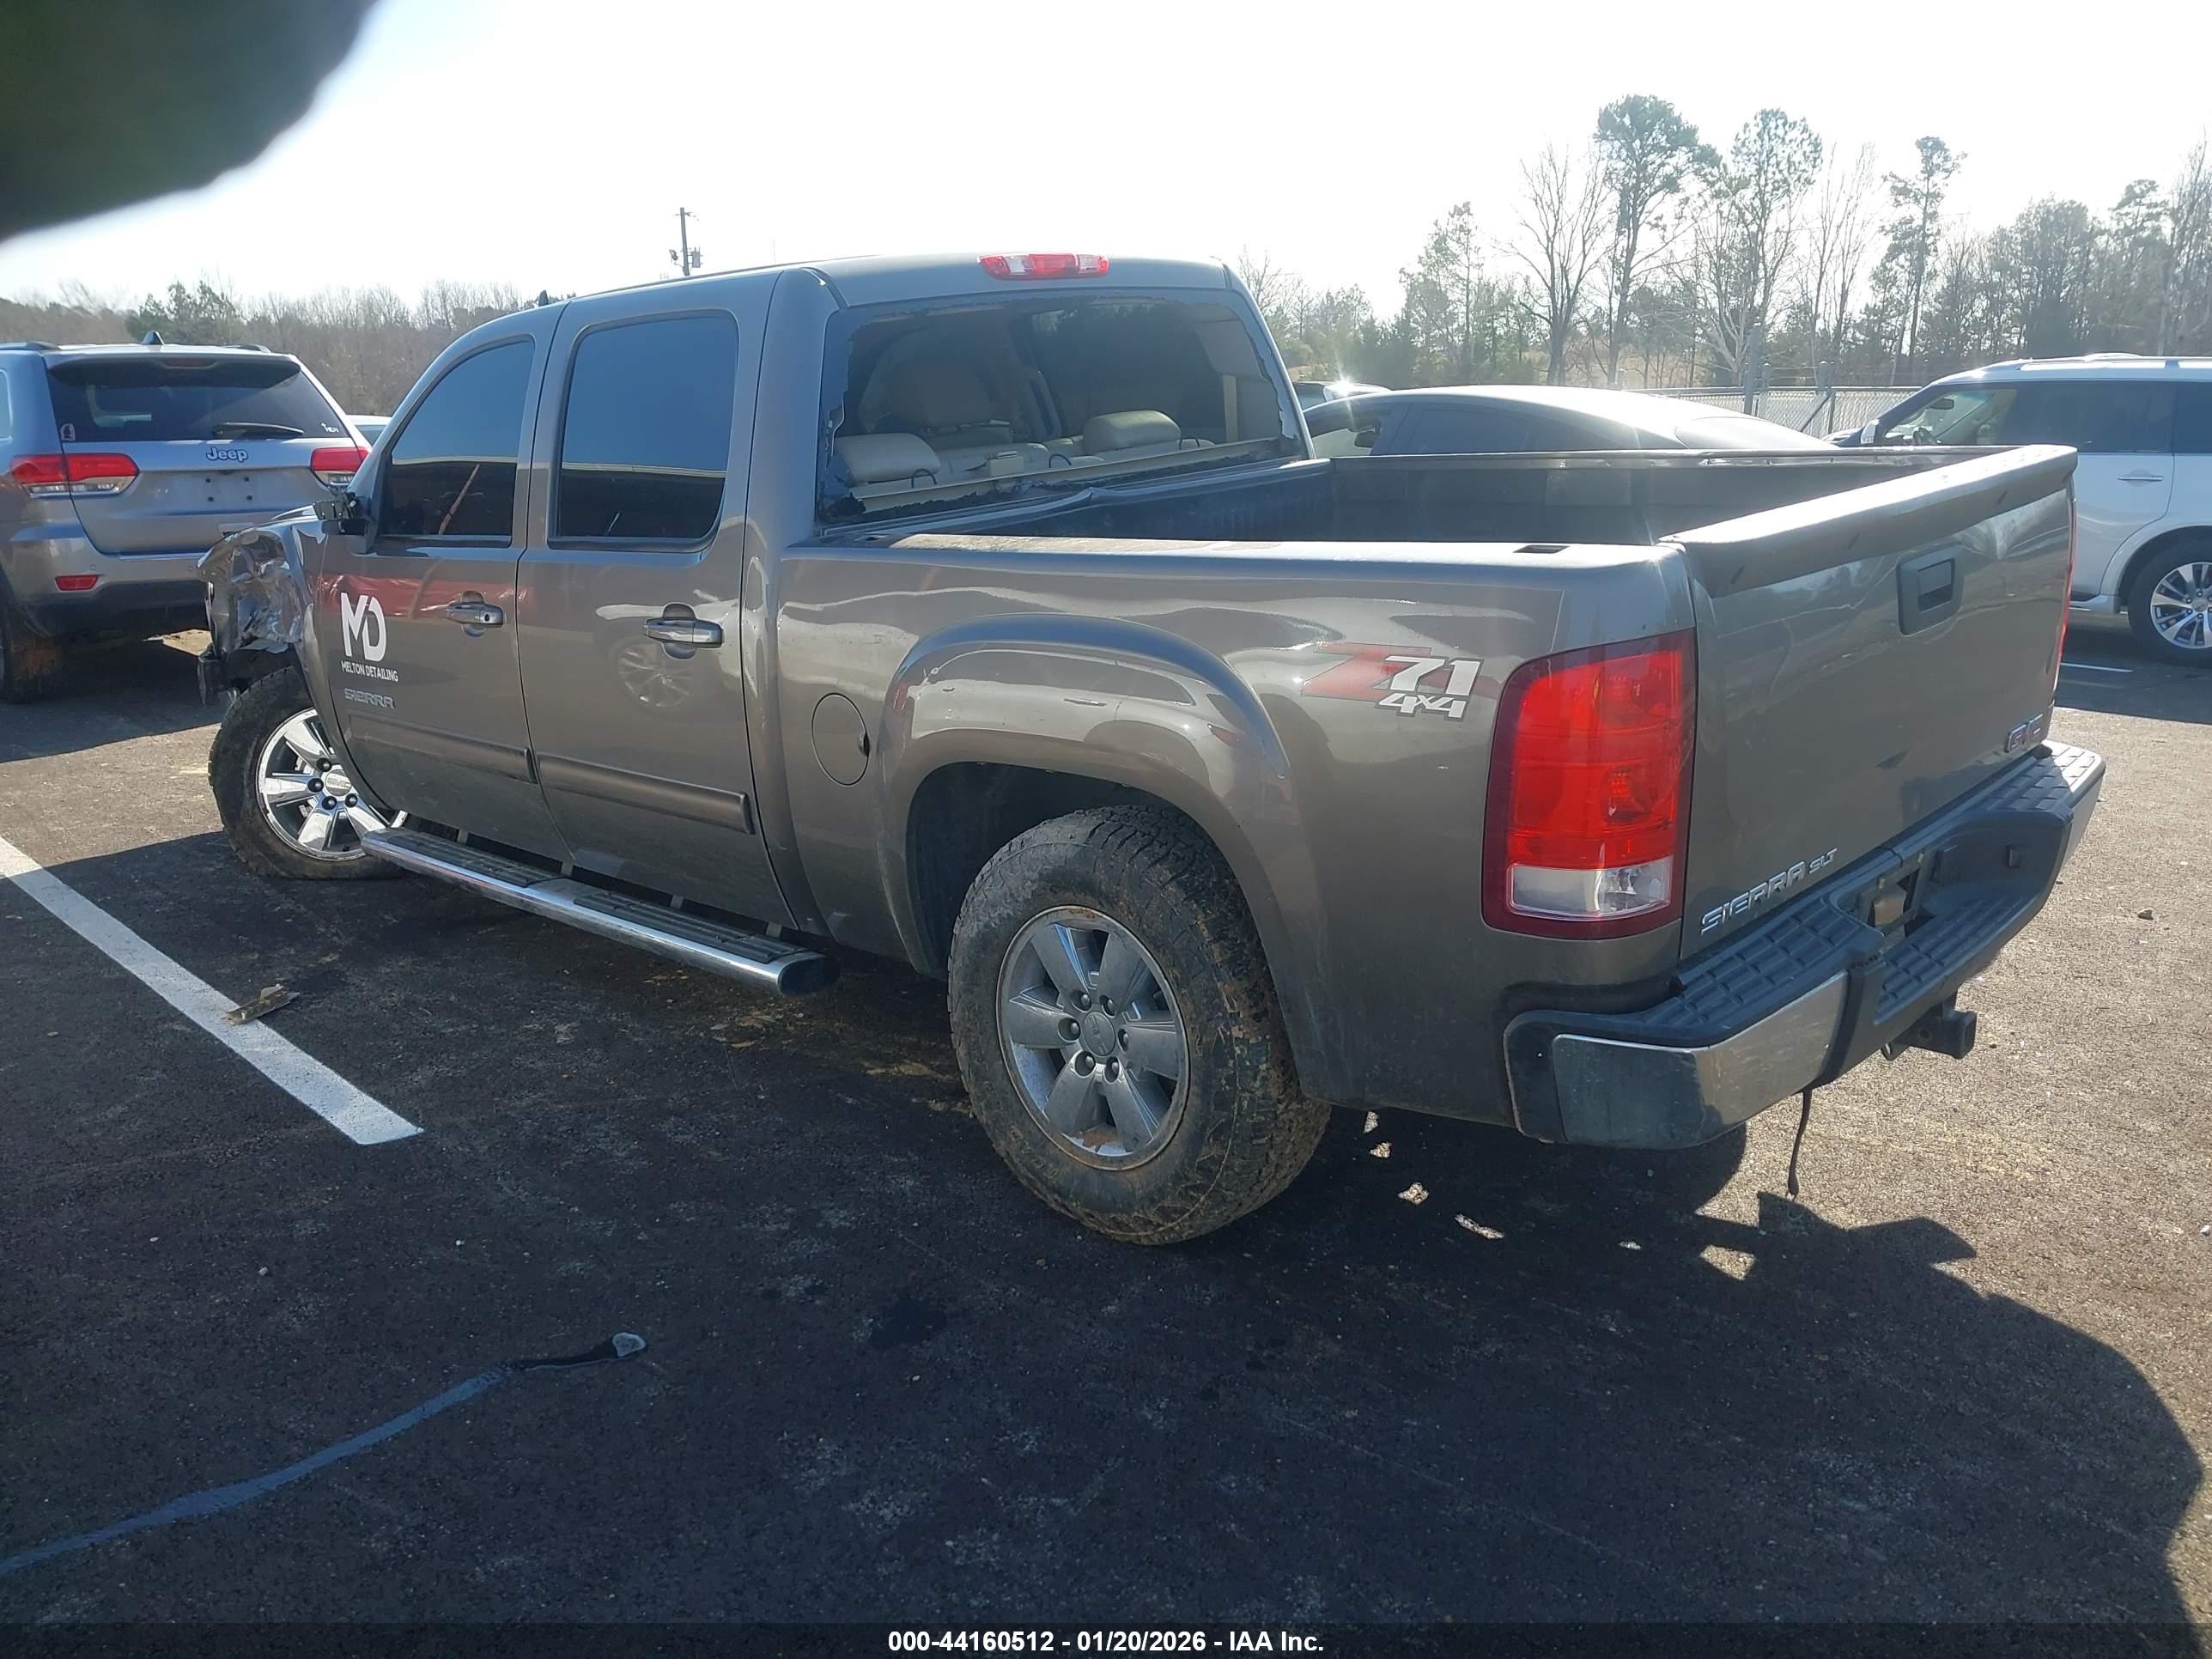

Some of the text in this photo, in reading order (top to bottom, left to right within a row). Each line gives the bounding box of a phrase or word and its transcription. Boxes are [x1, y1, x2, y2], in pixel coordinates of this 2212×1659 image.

[206, 447, 248, 463] Jeep
[341, 660, 399, 683] MELTON DETAILING
[344, 688, 395, 709] SIERRA
[1700, 847, 1839, 936] SIERRA SLT
